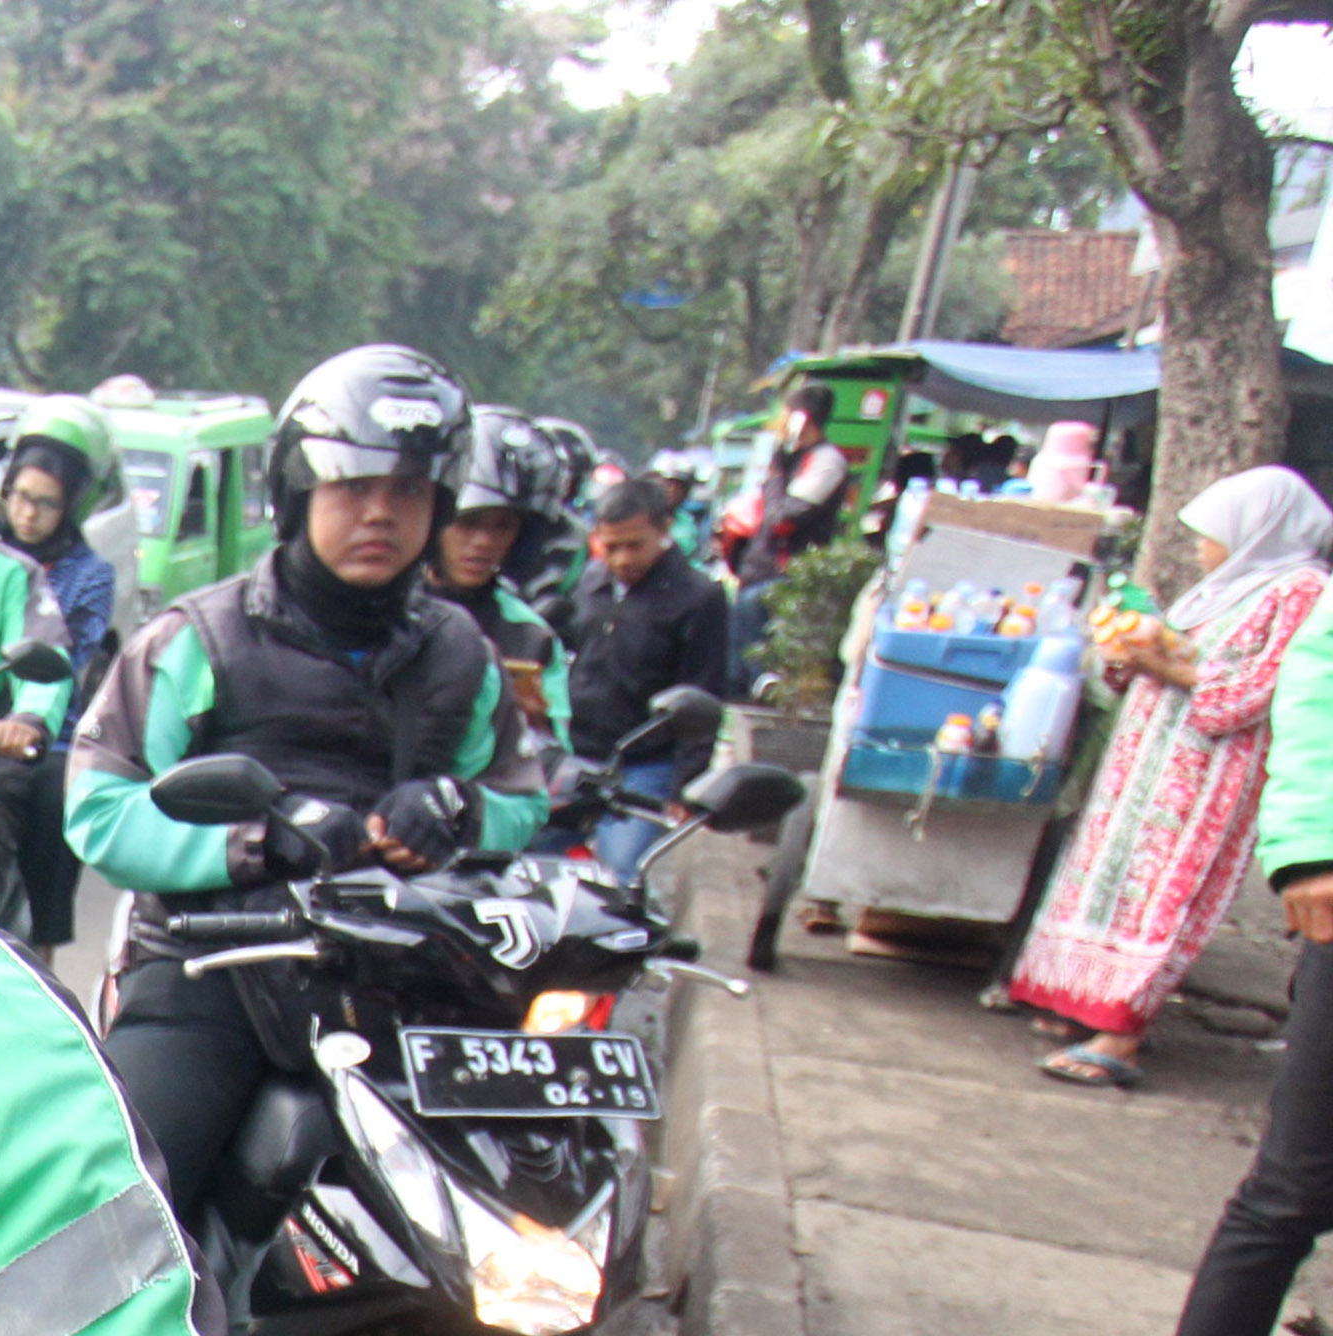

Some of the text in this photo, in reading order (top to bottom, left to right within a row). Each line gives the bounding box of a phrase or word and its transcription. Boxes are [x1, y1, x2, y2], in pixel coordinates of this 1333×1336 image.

[409, 1035, 637, 1078] F 5343 CV
[301, 1201, 360, 1277] HONDA
